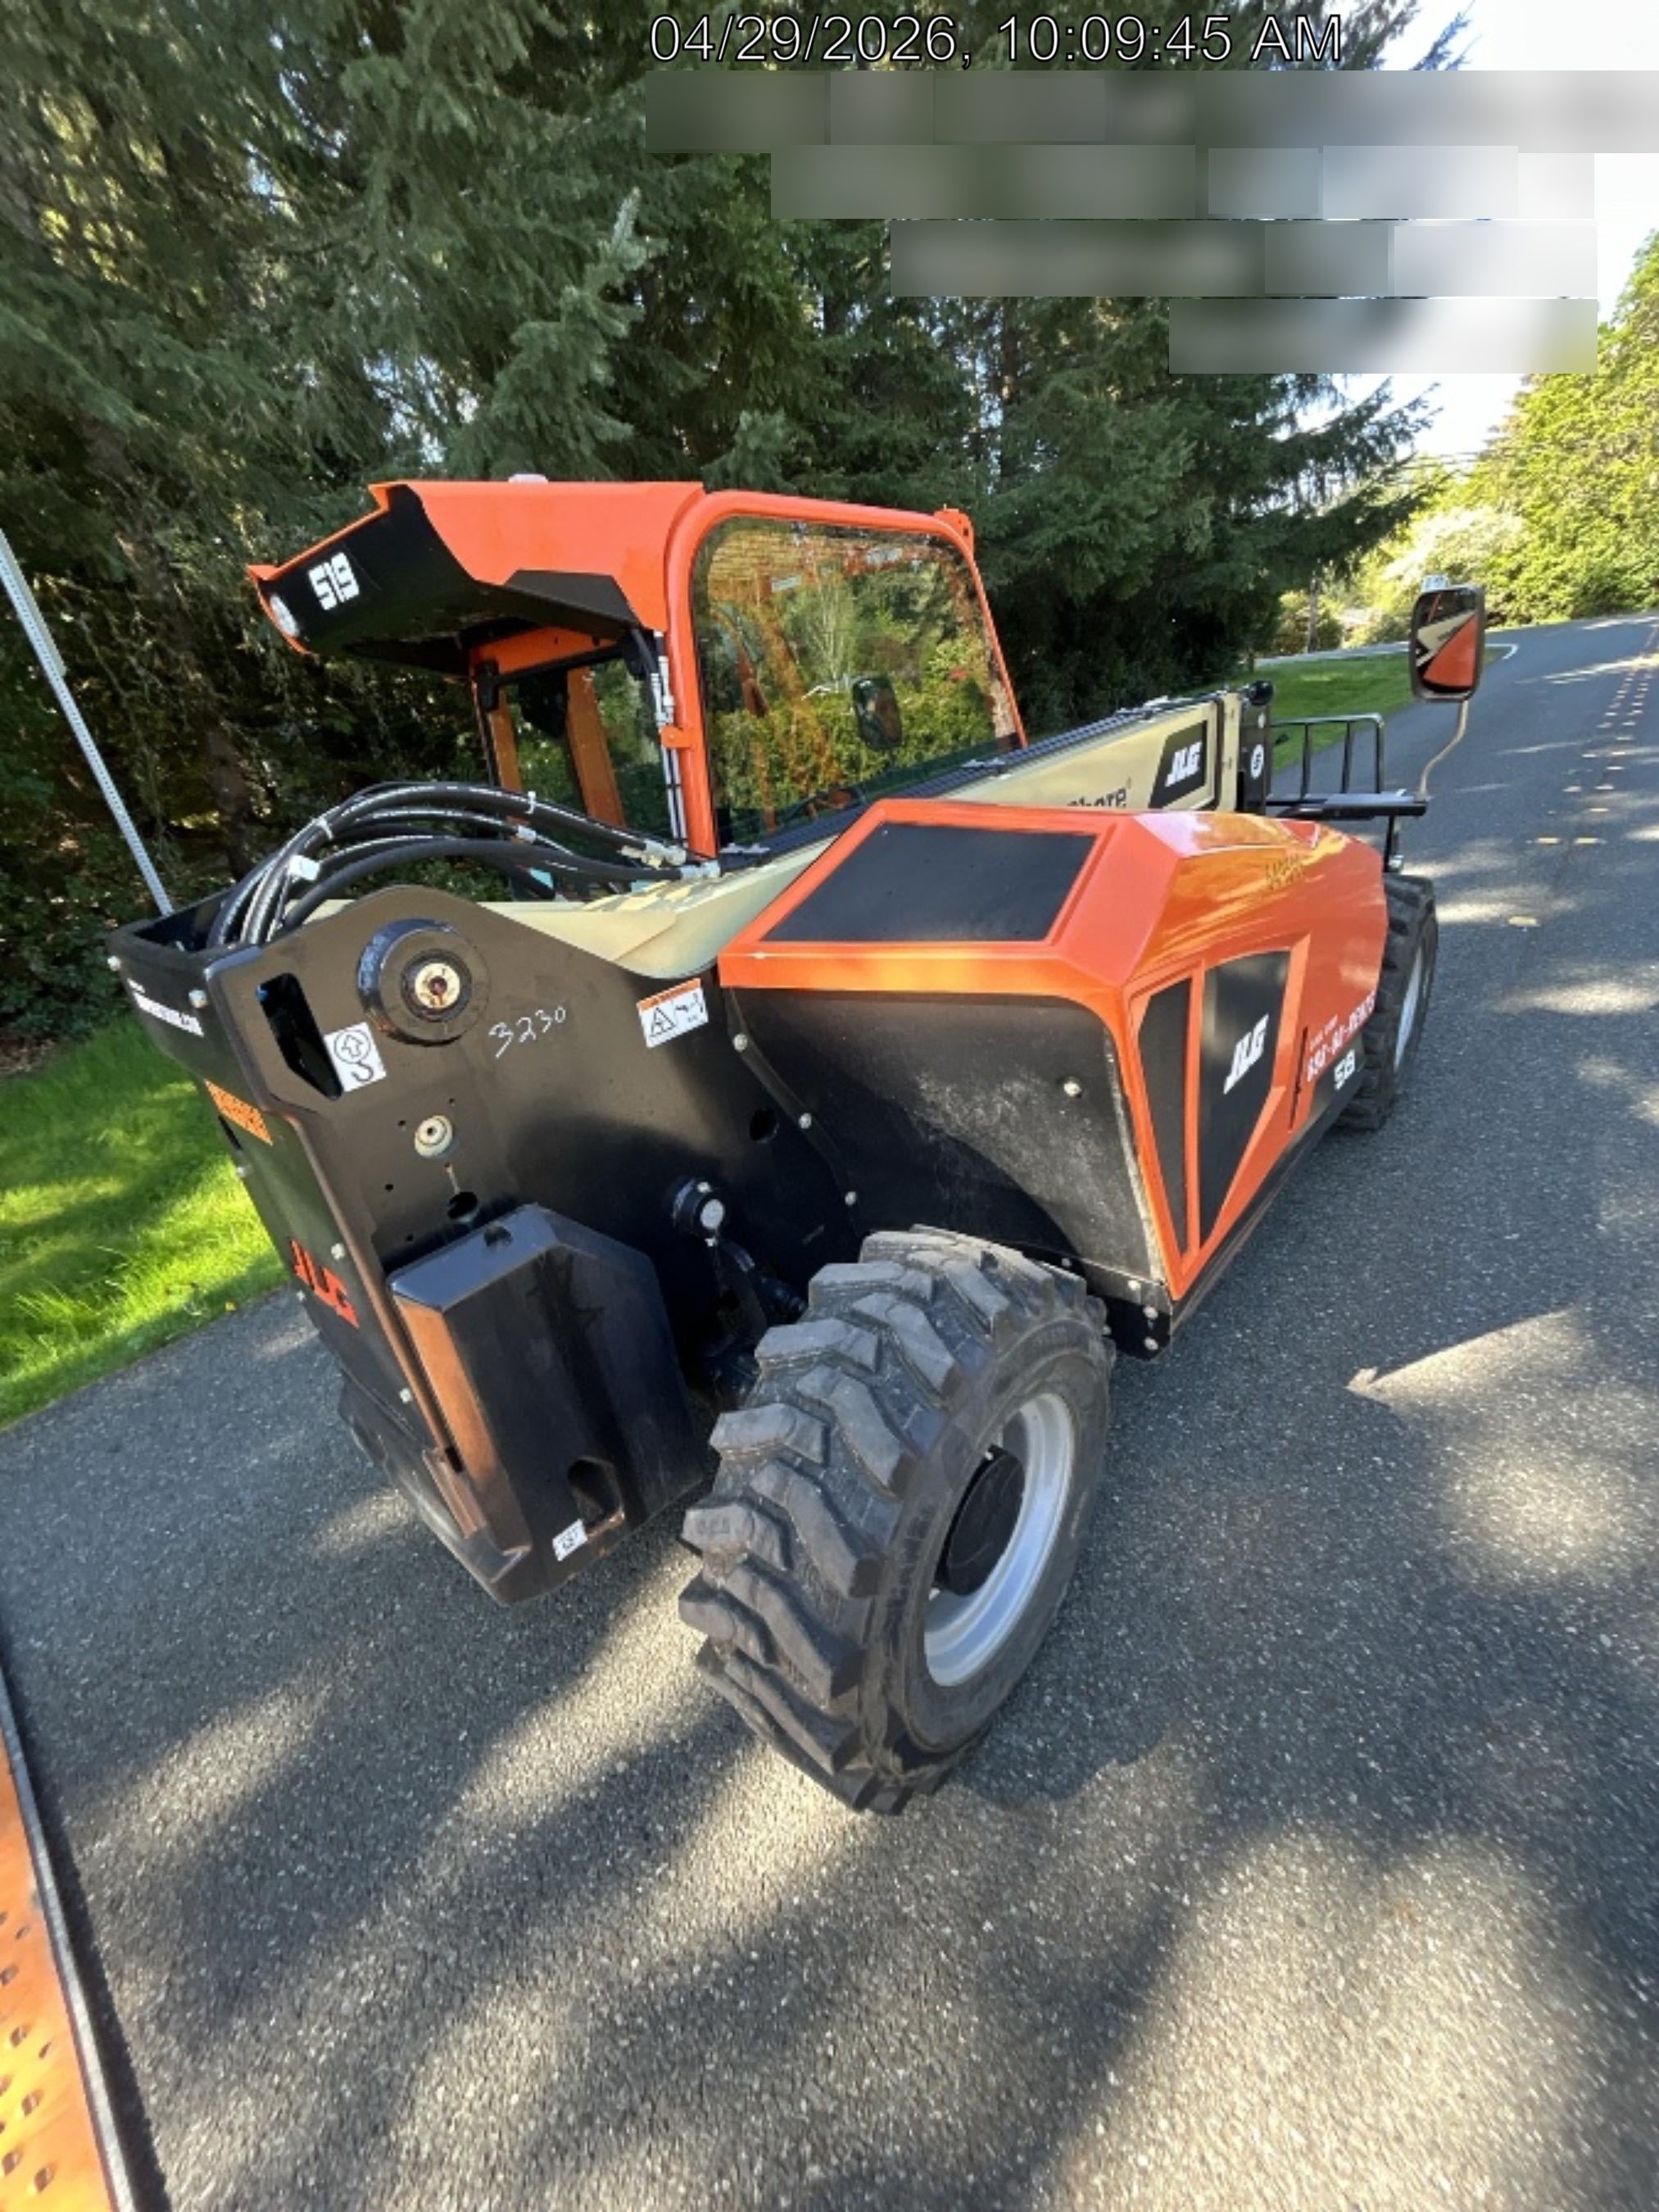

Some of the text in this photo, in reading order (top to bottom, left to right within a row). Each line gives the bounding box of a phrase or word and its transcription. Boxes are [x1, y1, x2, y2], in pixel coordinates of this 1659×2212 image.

[1165, 741, 1203, 786] JLG
[488, 1006, 566, 1058] 3230
[1223, 1014, 1269, 1095] JLG
